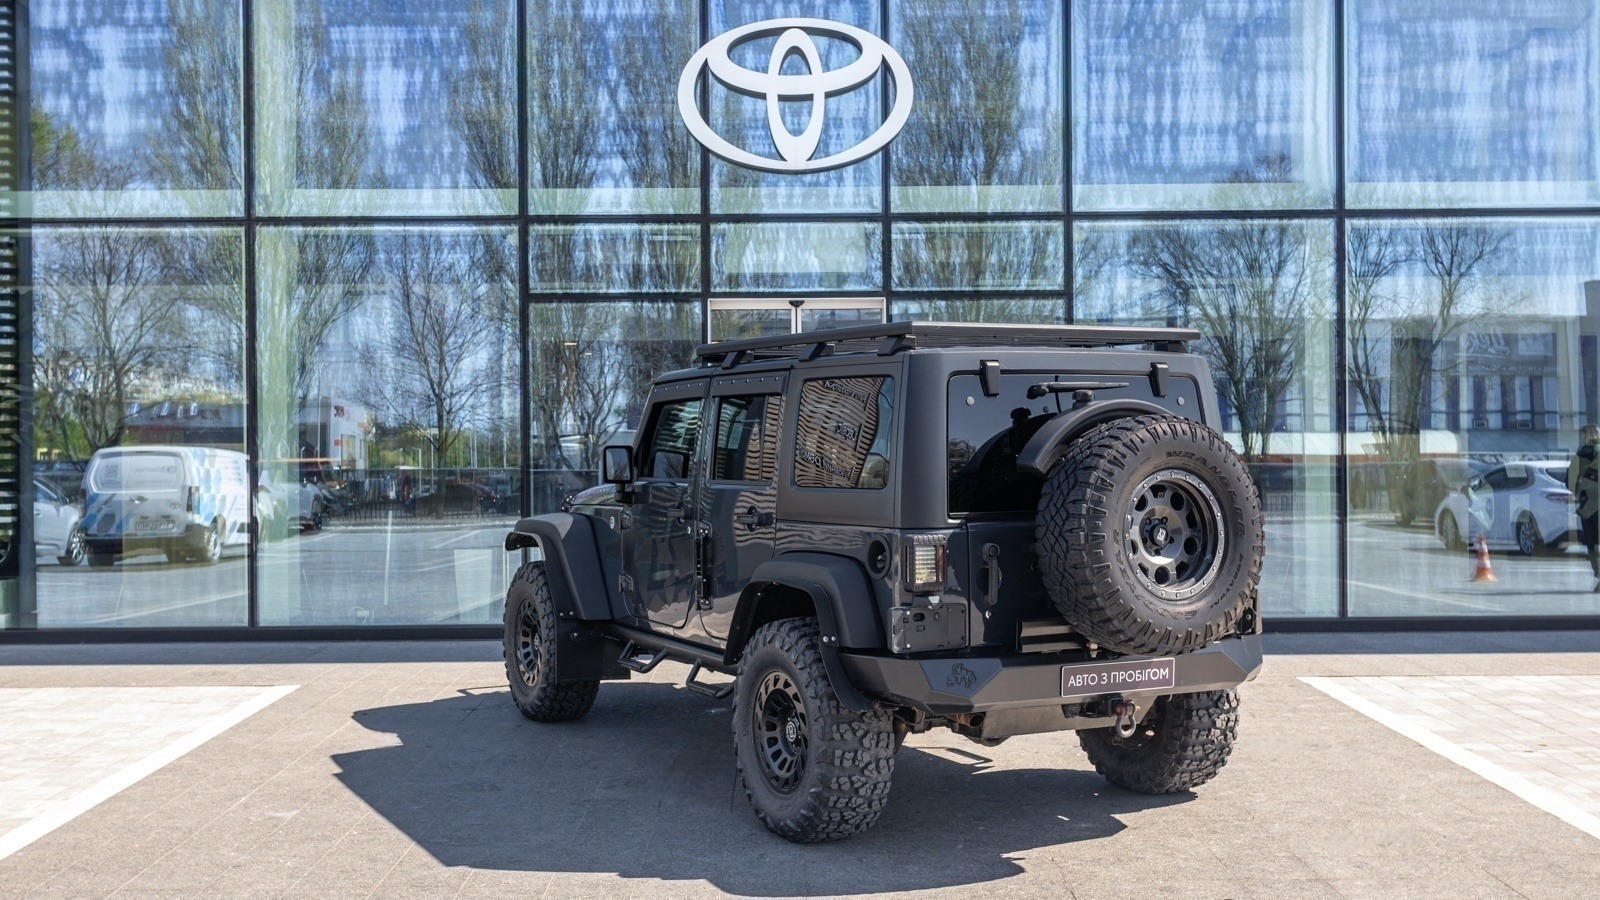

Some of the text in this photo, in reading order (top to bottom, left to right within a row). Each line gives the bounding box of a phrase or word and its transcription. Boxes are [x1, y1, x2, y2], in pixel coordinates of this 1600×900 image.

[1166, 451, 1245, 537] WRANGLER
[1113, 529, 1197, 620] GOODYEAR
[1210, 553, 1243, 610] DURATRAC
[1068, 667, 1169, 687] АВТО З ПРОБІГОМ
